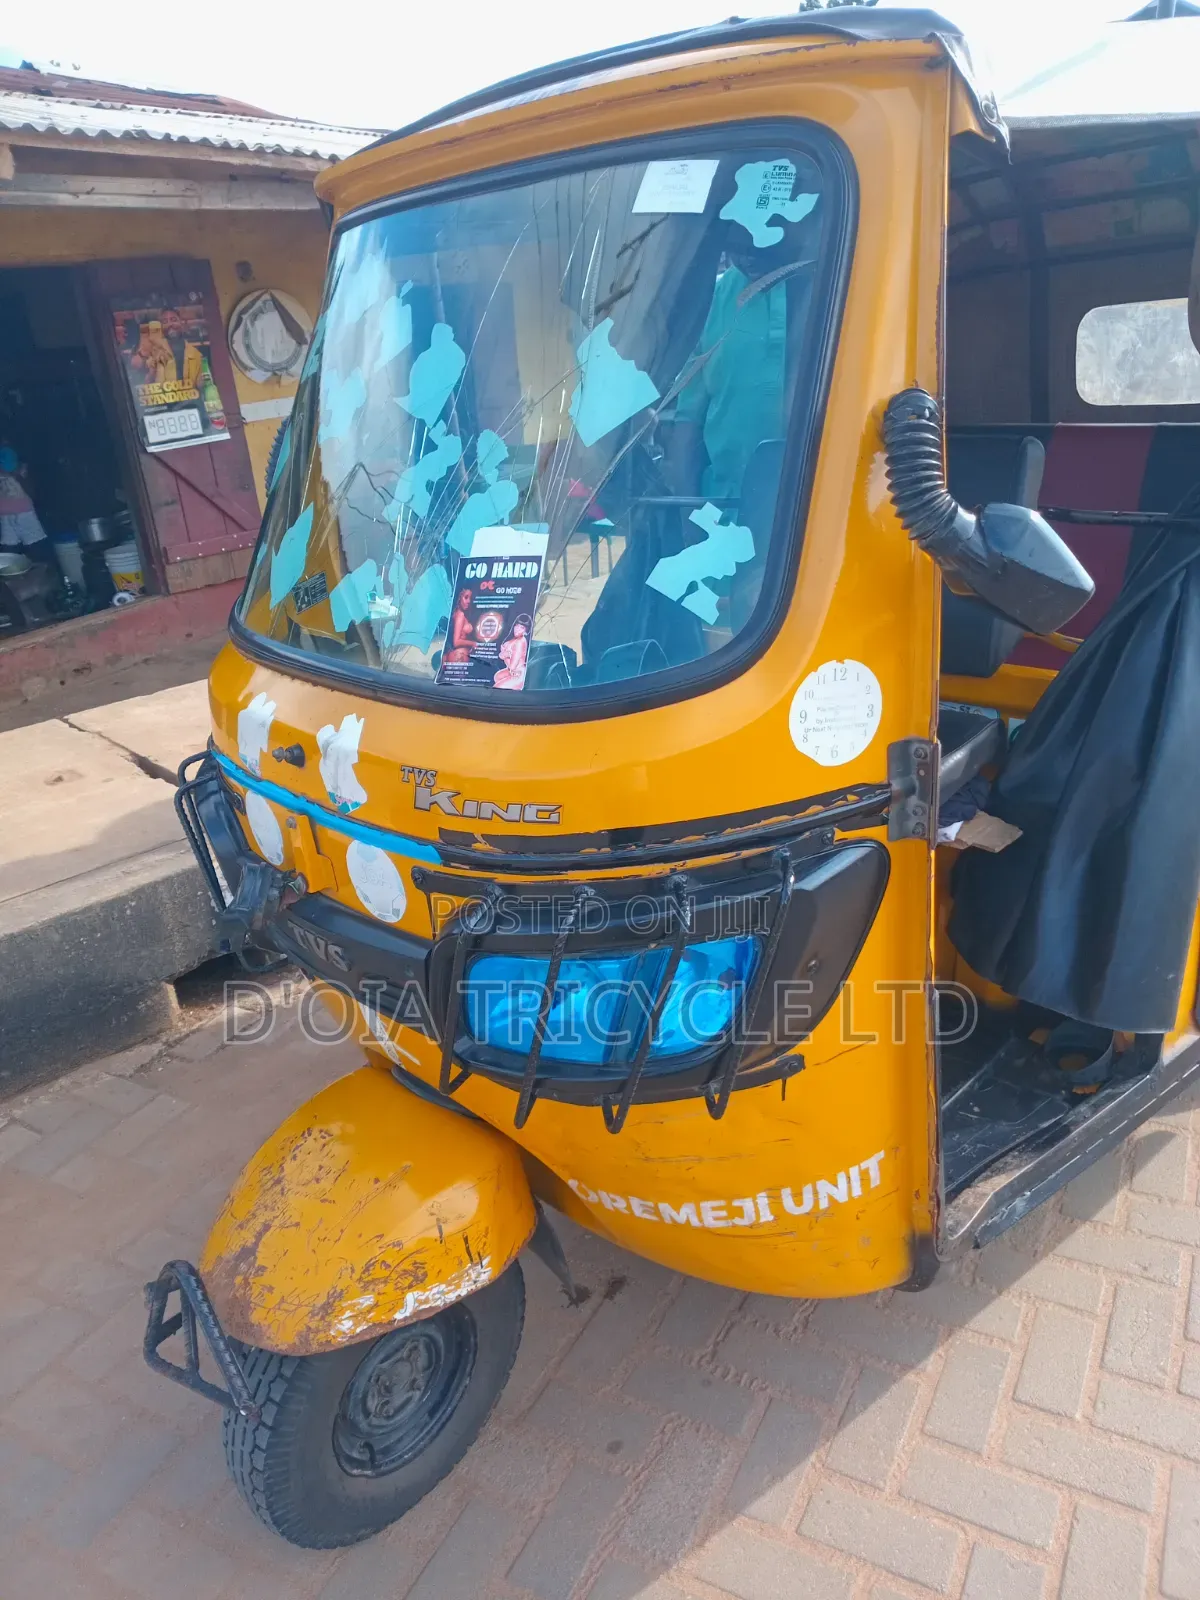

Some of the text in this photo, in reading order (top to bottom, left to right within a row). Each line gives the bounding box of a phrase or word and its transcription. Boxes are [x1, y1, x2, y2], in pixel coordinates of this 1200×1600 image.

[136, 379, 193, 396] THE GOLD
[139, 388, 200, 406] STANDARD
[465, 562, 538, 578] GO HARD
[832, 667, 848, 682] 12
[799, 709, 808, 724] 9
[867, 704, 875, 718] 3
[802, 733, 809, 744] 8
[400, 765, 438, 787] TVS
[413, 785, 563, 824] KING
[288, 919, 351, 972] TVS
[567, 1150, 886, 1229] OREMEJI UNIT
